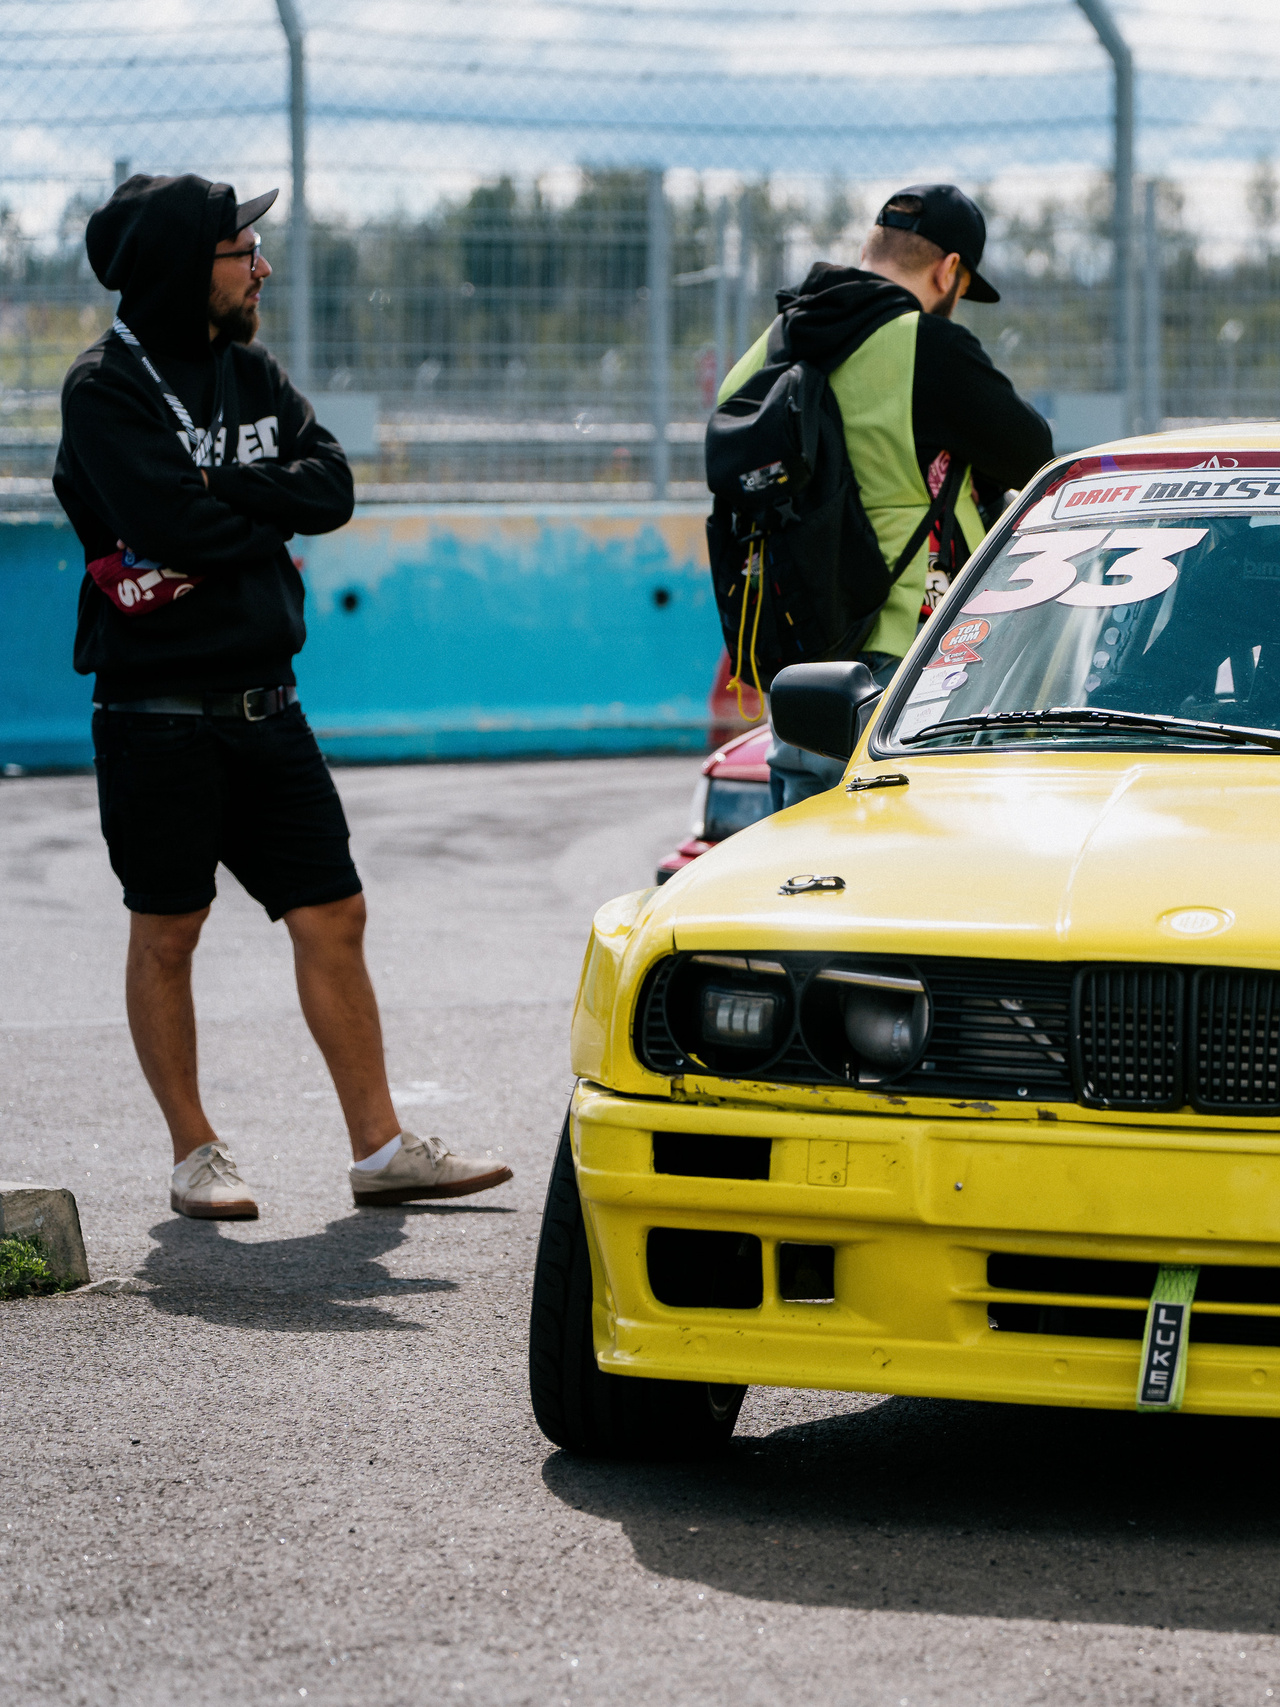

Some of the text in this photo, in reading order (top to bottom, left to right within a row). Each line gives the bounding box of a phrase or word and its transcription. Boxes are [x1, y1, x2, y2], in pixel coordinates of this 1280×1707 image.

[1064, 485, 1143, 508] DRIFT
[959, 528, 1210, 615] 33
[1149, 1308, 1178, 1386] LUKE
